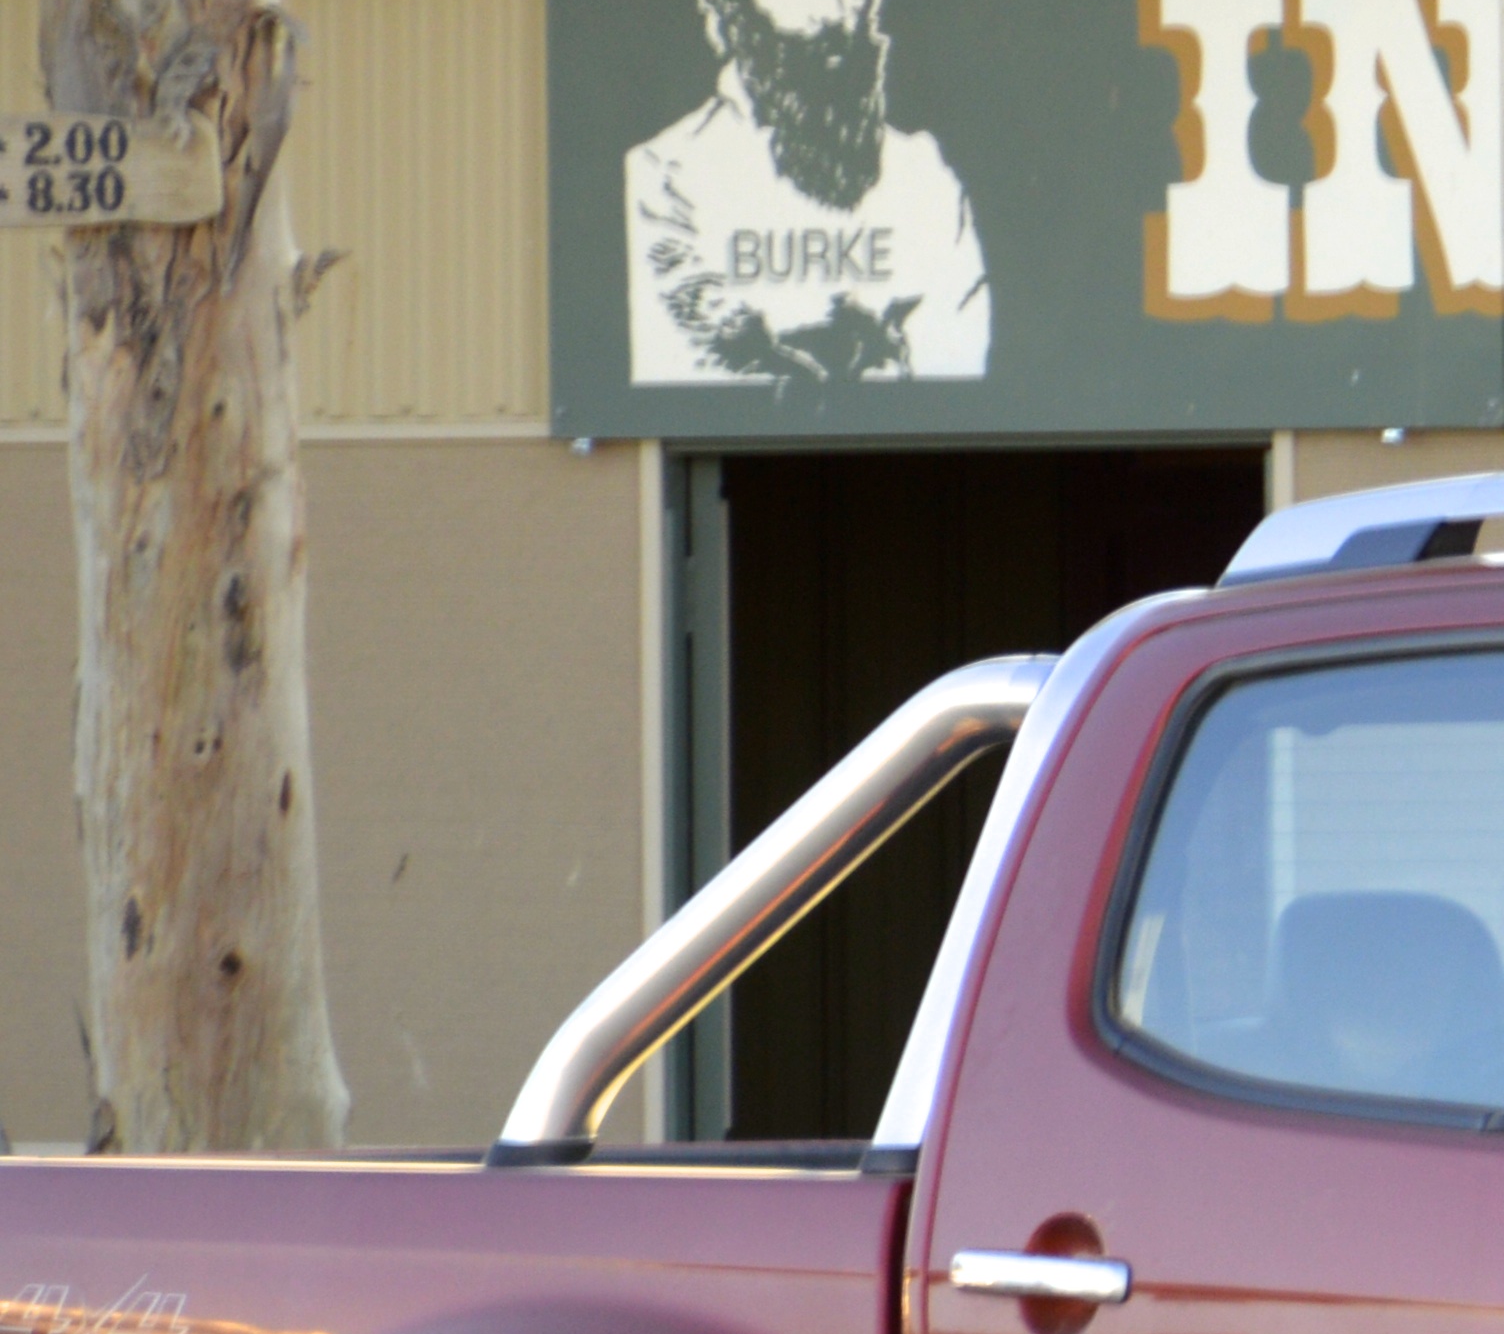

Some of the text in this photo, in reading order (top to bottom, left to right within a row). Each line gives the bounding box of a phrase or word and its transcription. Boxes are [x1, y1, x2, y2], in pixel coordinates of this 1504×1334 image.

[25, 120, 128, 165] 2.00
[27, 166, 124, 212] 8.30
[729, 226, 894, 285] BURKE
